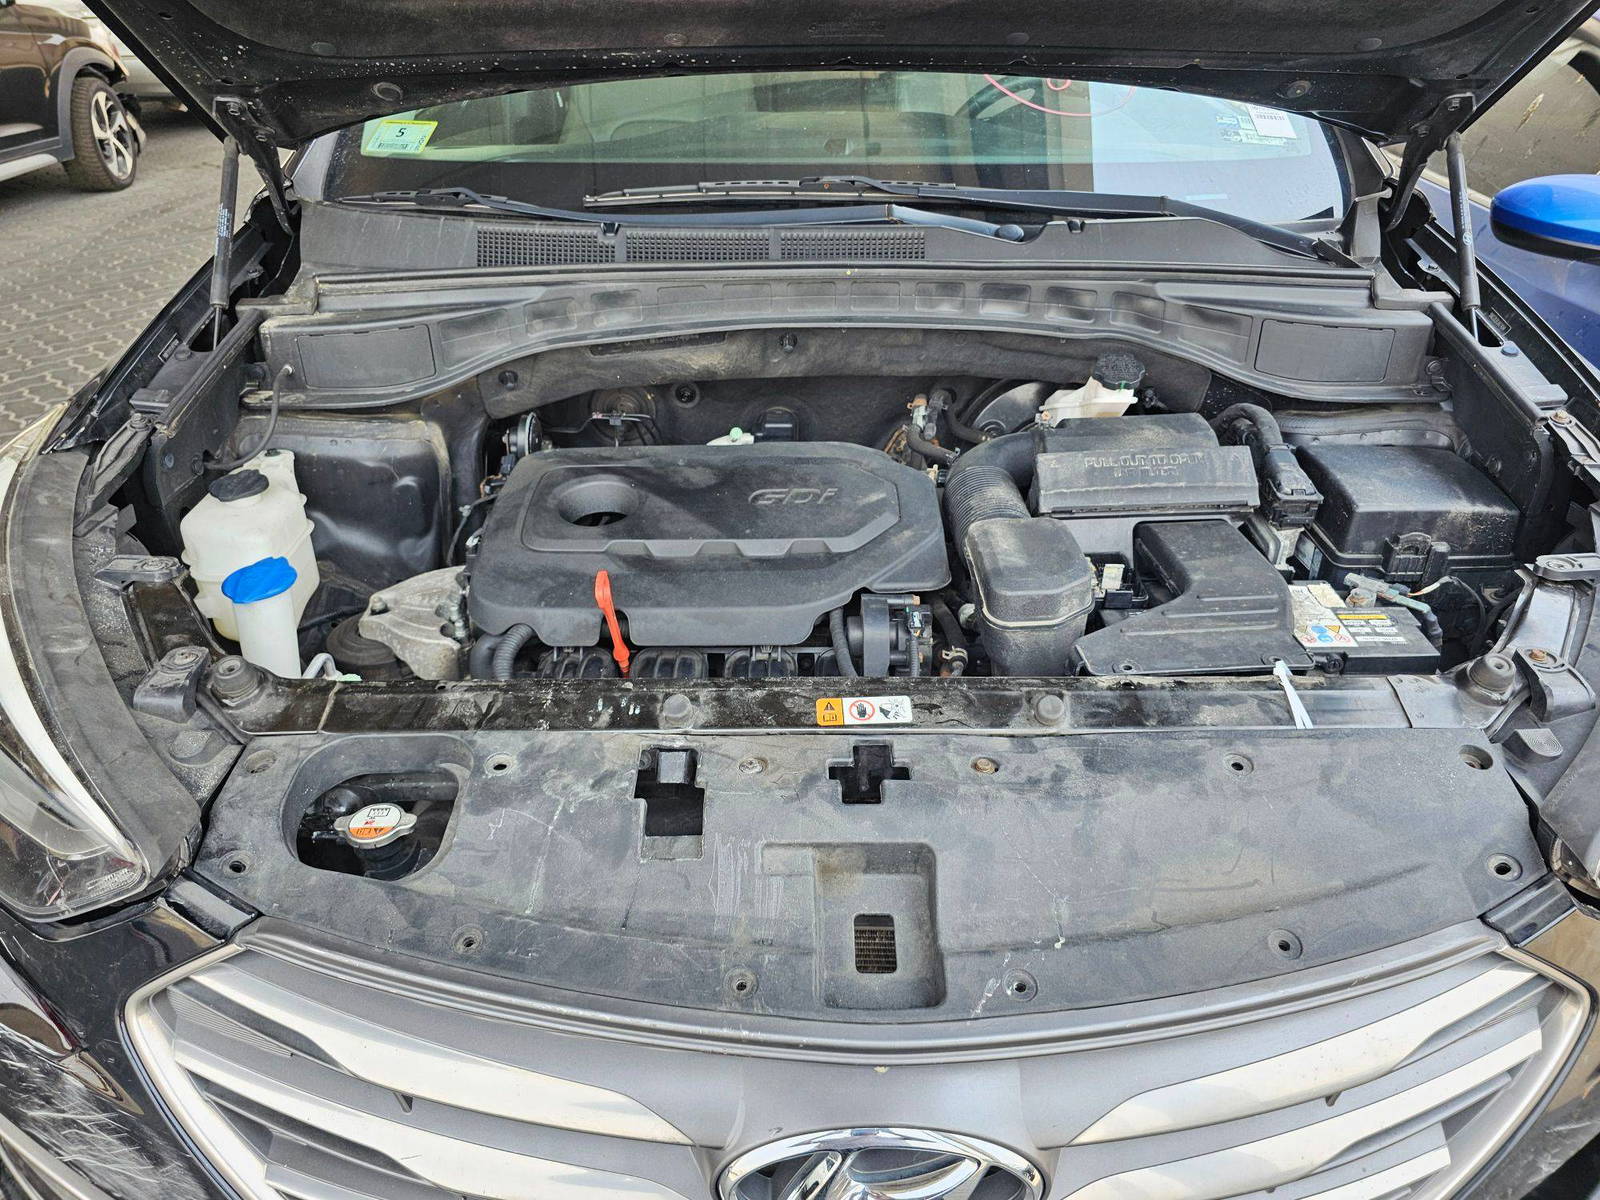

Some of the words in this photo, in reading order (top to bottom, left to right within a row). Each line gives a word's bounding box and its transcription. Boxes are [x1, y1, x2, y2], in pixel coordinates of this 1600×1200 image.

[1084, 456, 1119, 468] PULL
[1120, 454, 1147, 466] OUT
[1149, 453, 1166, 465] TO
